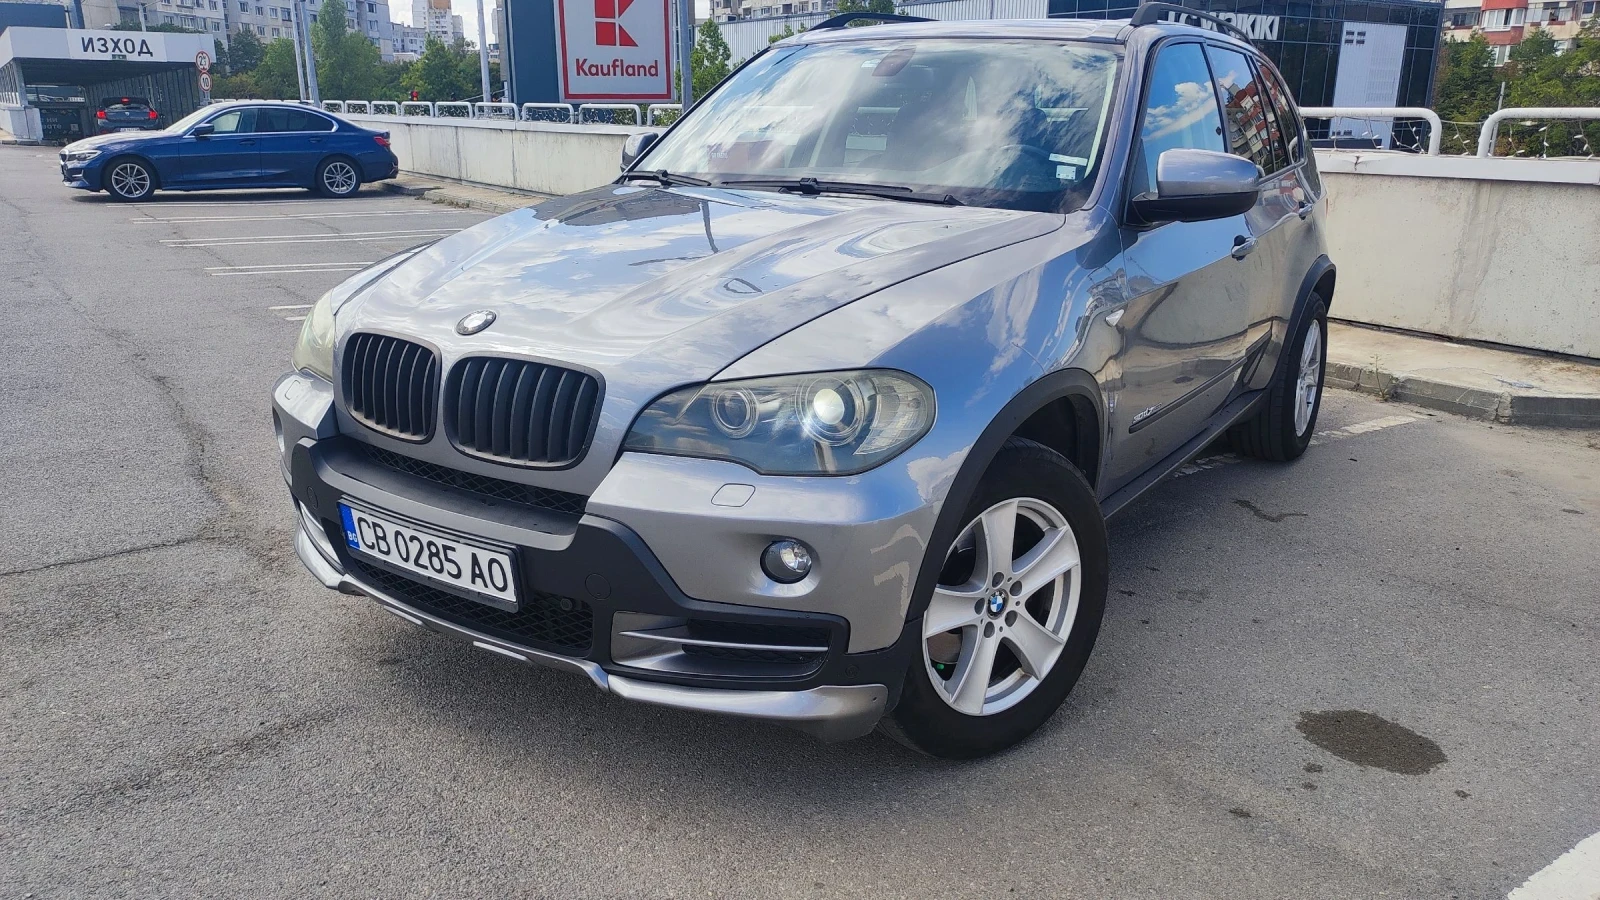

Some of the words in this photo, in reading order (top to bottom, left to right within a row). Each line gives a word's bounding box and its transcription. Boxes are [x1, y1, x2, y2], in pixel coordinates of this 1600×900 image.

[81, 37, 153, 57] ИЗХОД
[575, 58, 659, 77] Kaufland
[202, 77, 209, 88] 10
[347, 530, 358, 543] BG
[357, 516, 391, 556] CB
[394, 530, 462, 580] 0285
